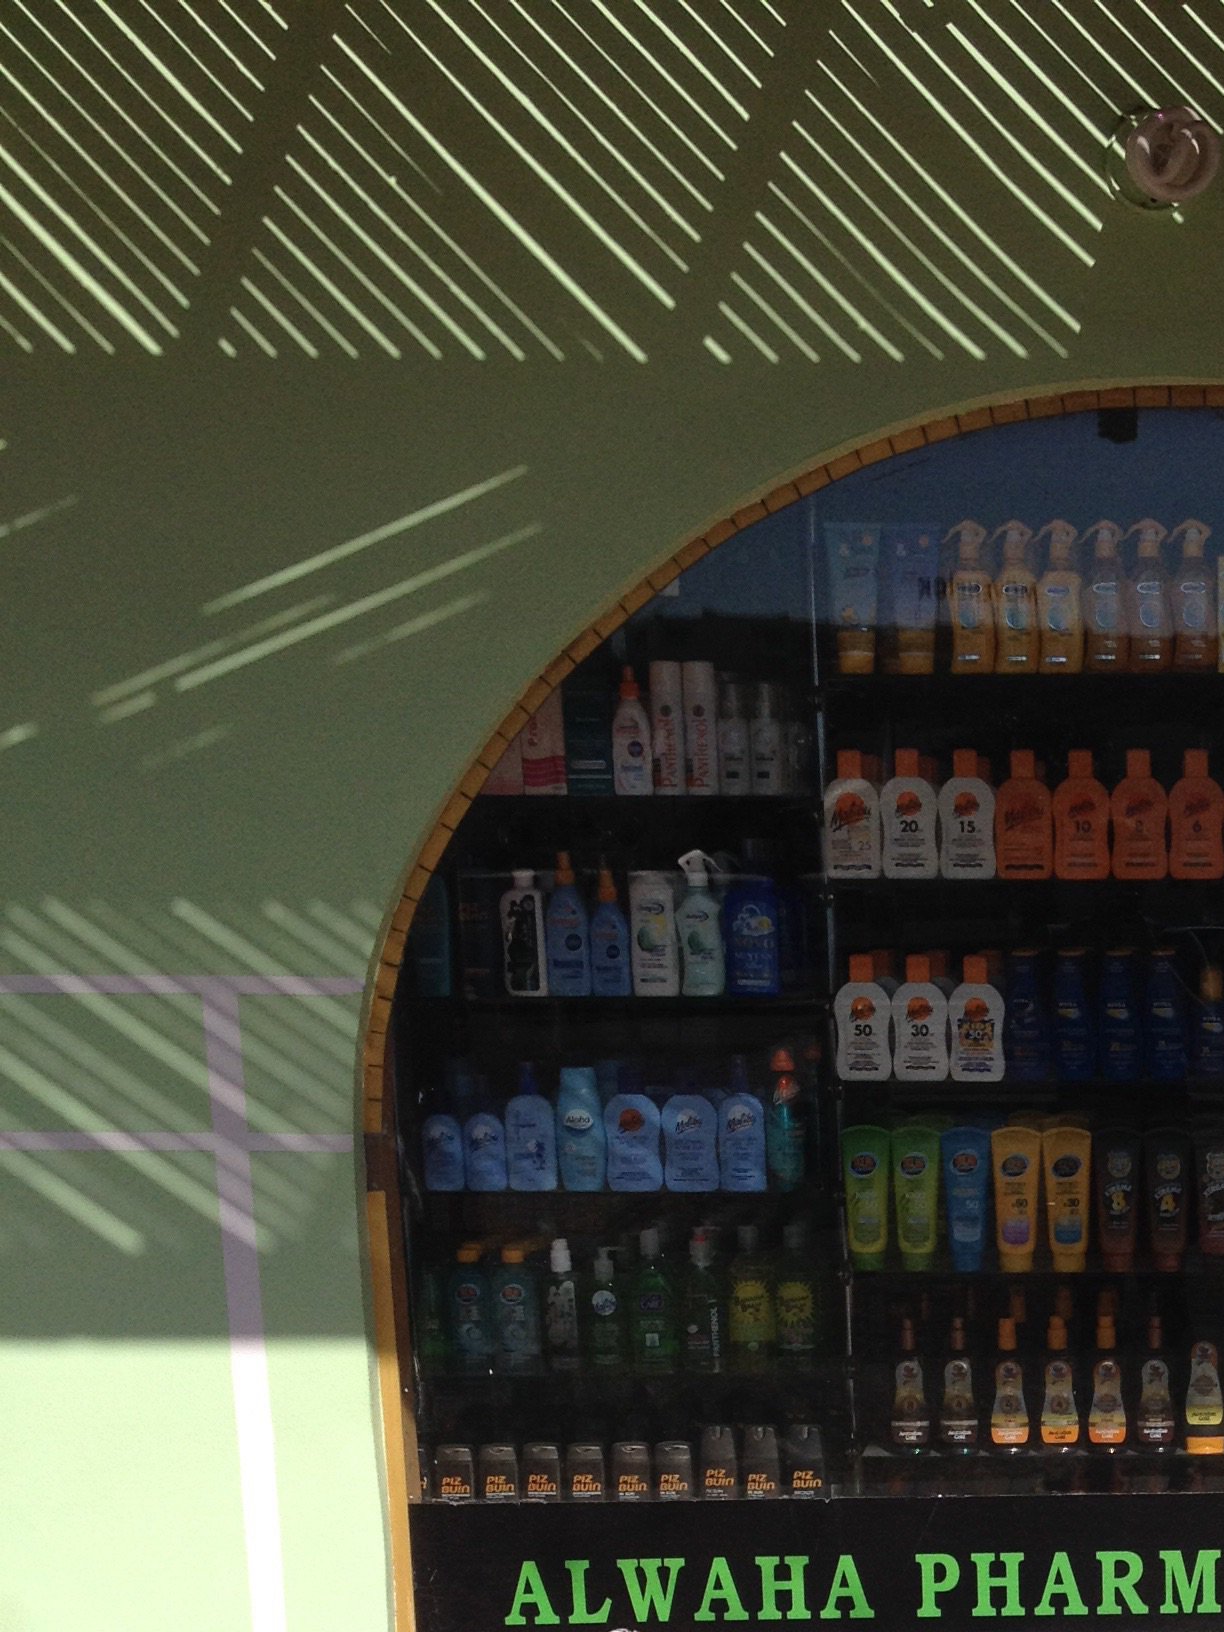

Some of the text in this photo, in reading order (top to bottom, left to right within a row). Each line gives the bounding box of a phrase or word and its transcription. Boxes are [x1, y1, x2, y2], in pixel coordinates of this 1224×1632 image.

[901, 820, 918, 833] 20
[959, 820, 976, 833] 15
[1075, 820, 1092, 833] 10
[1192, 820, 1202, 833] 6
[854, 1024, 872, 1036] 50
[911, 1024, 929, 1037] 30
[566, 1115, 591, 1124] Aloha
[710, 1306, 720, 1357] PANTHENOL
[706, 1469, 726, 1477] PIZ
[748, 1473, 768, 1481] PIZ
[793, 1470, 815, 1479] PIZ
[442, 1477, 462, 1485] PIZ
[486, 1475, 507, 1484] PIZ
[528, 1474, 549, 1483] PIZ
[573, 1474, 594, 1483] PIZ
[619, 1475, 640, 1483] PIZ
[661, 1474, 680, 1482] PIZ
[505, 1555, 874, 1625] ALWAHA
